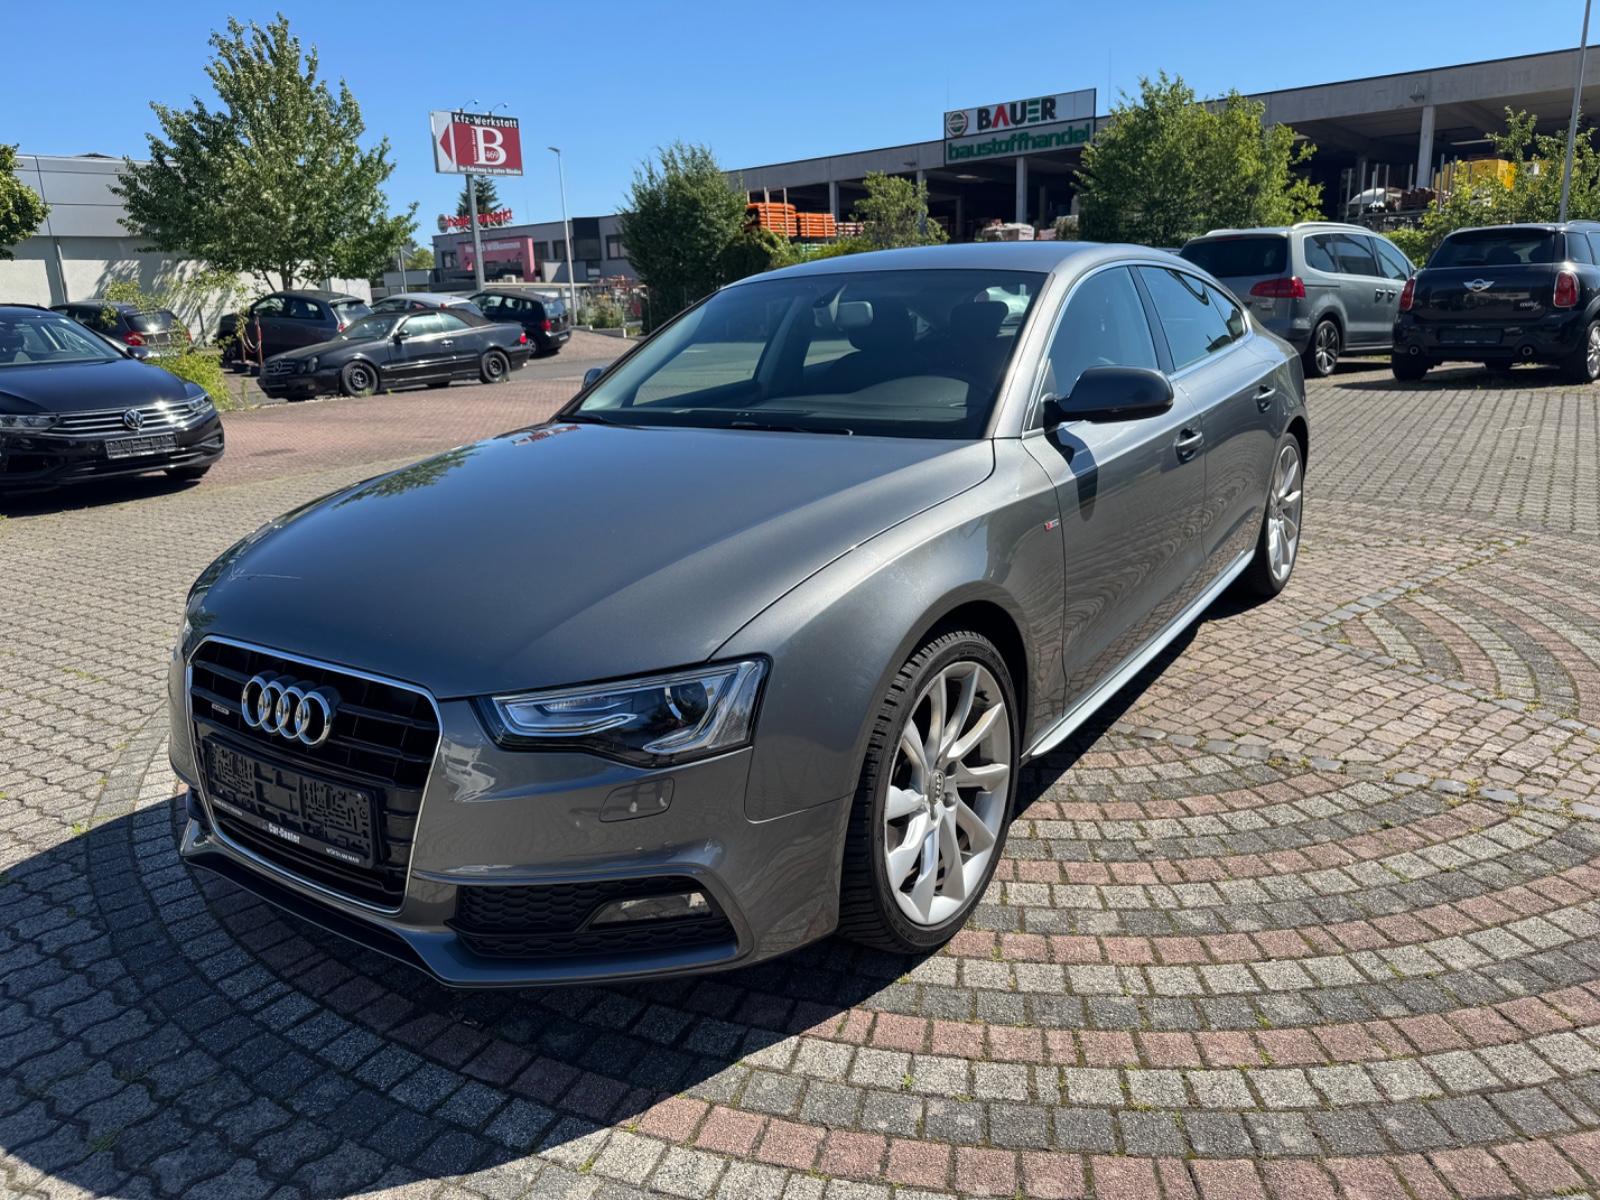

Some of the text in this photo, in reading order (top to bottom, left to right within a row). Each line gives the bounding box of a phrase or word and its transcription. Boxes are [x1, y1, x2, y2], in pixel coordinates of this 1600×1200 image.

[454, 114, 518, 129] Kfz-Werkstatt
[977, 97, 1057, 131] BAUER
[470, 125, 507, 166] B
[948, 123, 1090, 161] baustoffhandel
